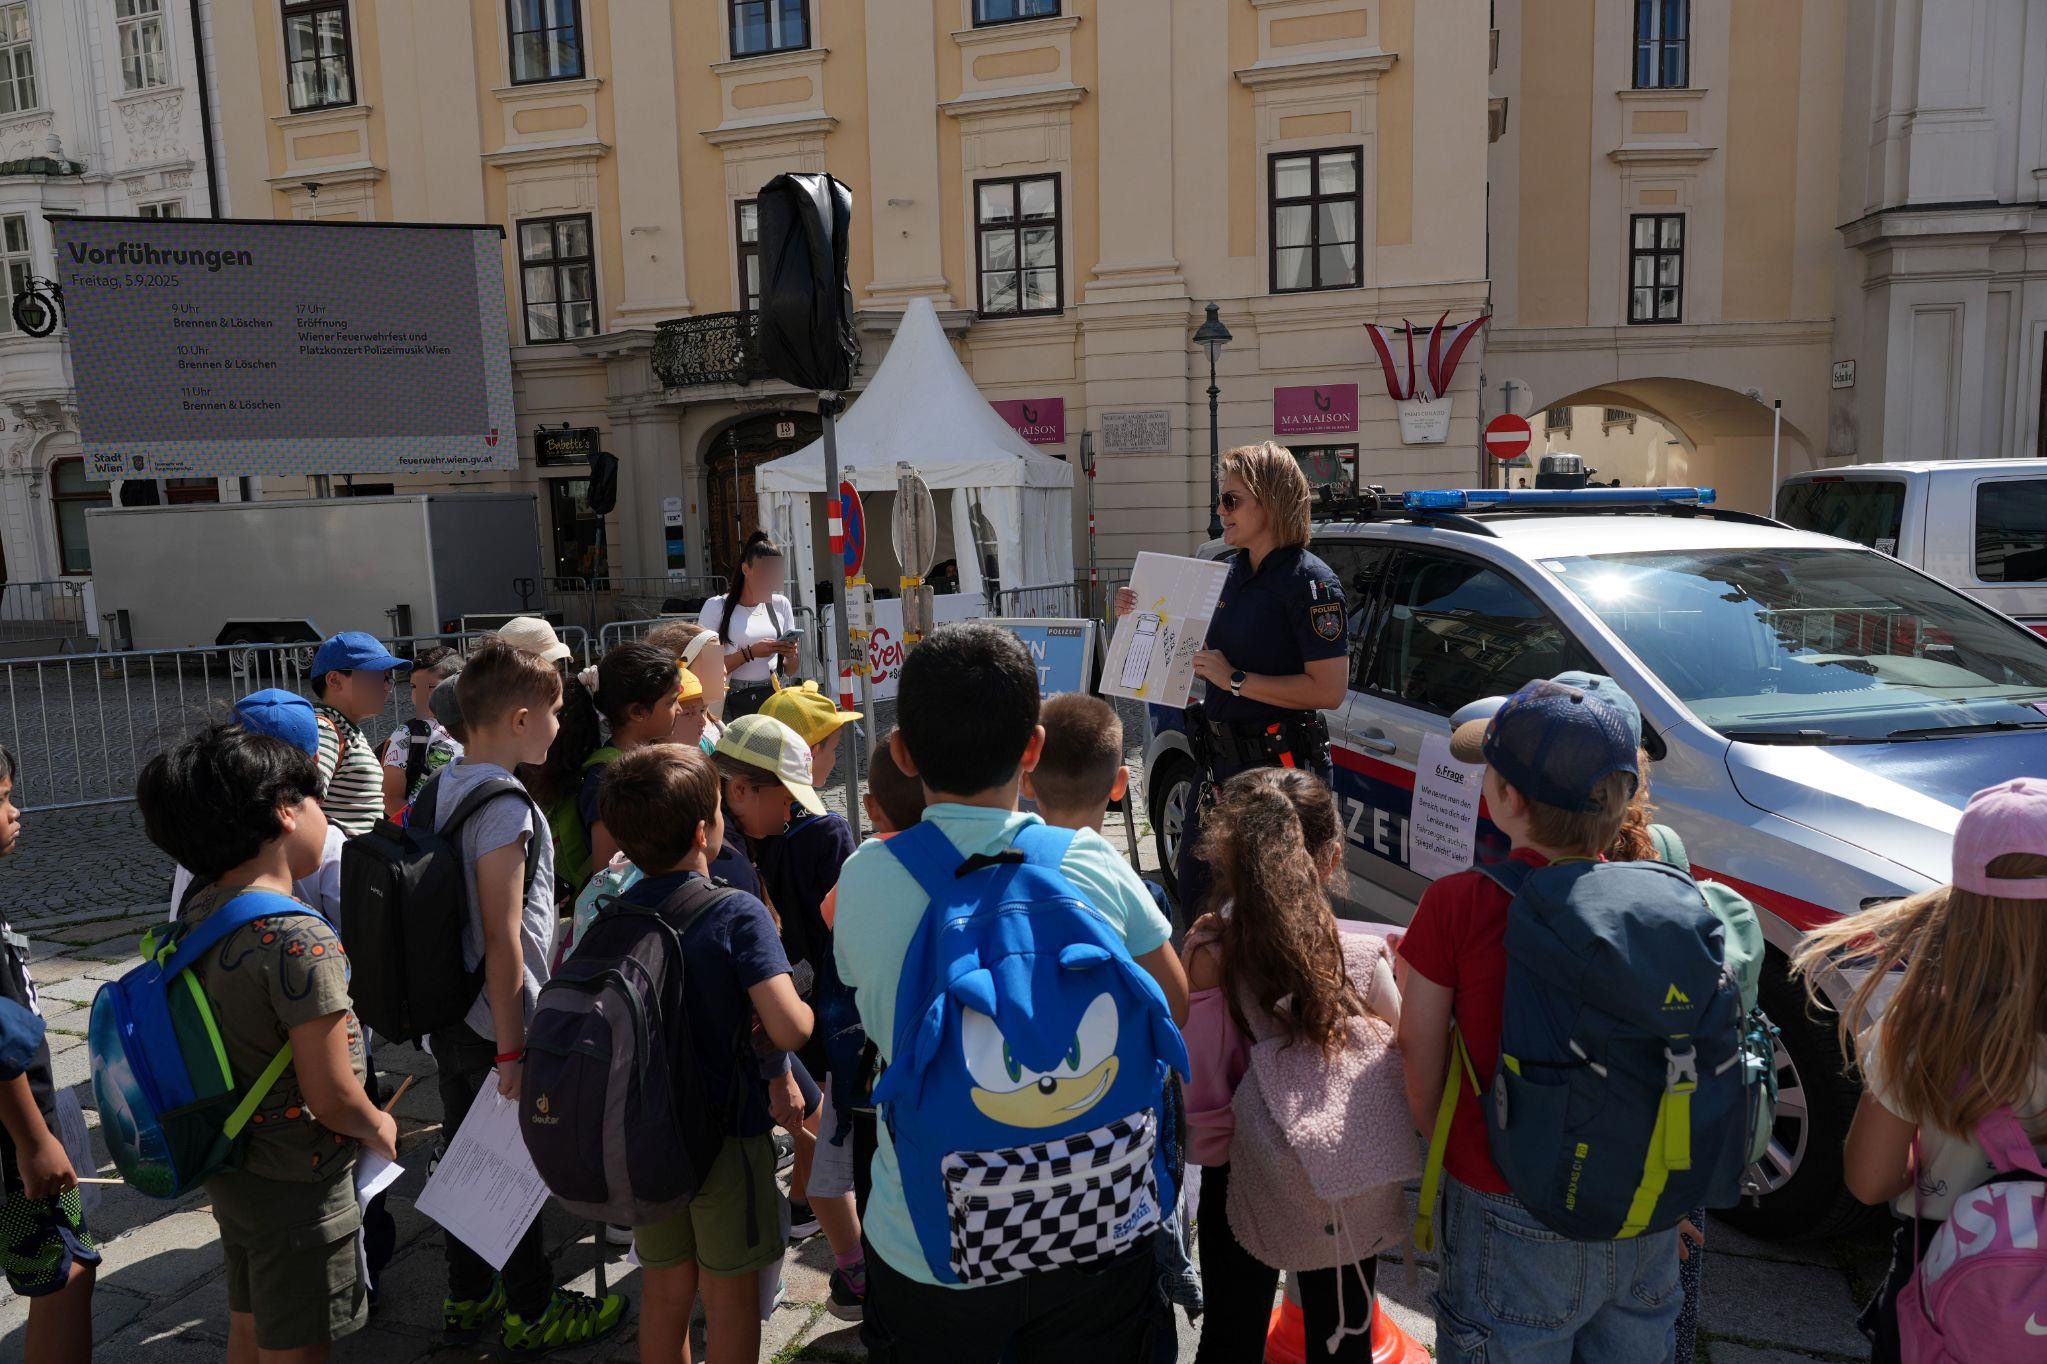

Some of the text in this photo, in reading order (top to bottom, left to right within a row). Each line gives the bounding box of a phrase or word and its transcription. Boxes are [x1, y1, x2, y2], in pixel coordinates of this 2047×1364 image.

[68, 241, 254, 272] Vorführungen
[71, 274, 180, 290] Freitag, 5.9.2025
[172, 304, 200, 314] 9 Uhr
[296, 304, 326, 314] 17 Uhr
[174, 318, 273, 328] Brennen & Löschen
[296, 318, 348, 329] Eröffnung
[298, 332, 428, 342] Wiener Feuerwehrfest und
[176, 345, 209, 355] 10 Uhr
[300, 345, 451, 355] Platzkonzert Polizeimusik Wien
[178, 360, 277, 369] Brennen & Löschen
[181, 387, 211, 397] 11 Uhr
[183, 400, 281, 410] Brennen & Löschen
[1281, 412, 1351, 424] MA MAISON
[781, 423, 790, 432] 13
[545, 438, 590, 450] Babette's
[94, 452, 122, 462] Stadt
[399, 455, 493, 465] feuerwehr.wien.gv.at
[95, 463, 123, 473] Wien
[1312, 606, 1338, 614] POLIZEI
[1435, 764, 1464, 784] 6.Frage
[1421, 784, 1472, 809] Wie nennt man den
[1418, 797, 1471, 823] Bereich, wo dich der
[1426, 815, 1459, 833] Lenker eines
[1416, 824, 1447, 842] Fahrzeuges,
[1447, 836, 1461, 847] auch
[1415, 836, 1433, 850] Spiegel
[1452, 851, 1468, 864] sieht?
[532, 1112, 560, 1125] deuter
[1578, 1145, 1586, 1156] 20
